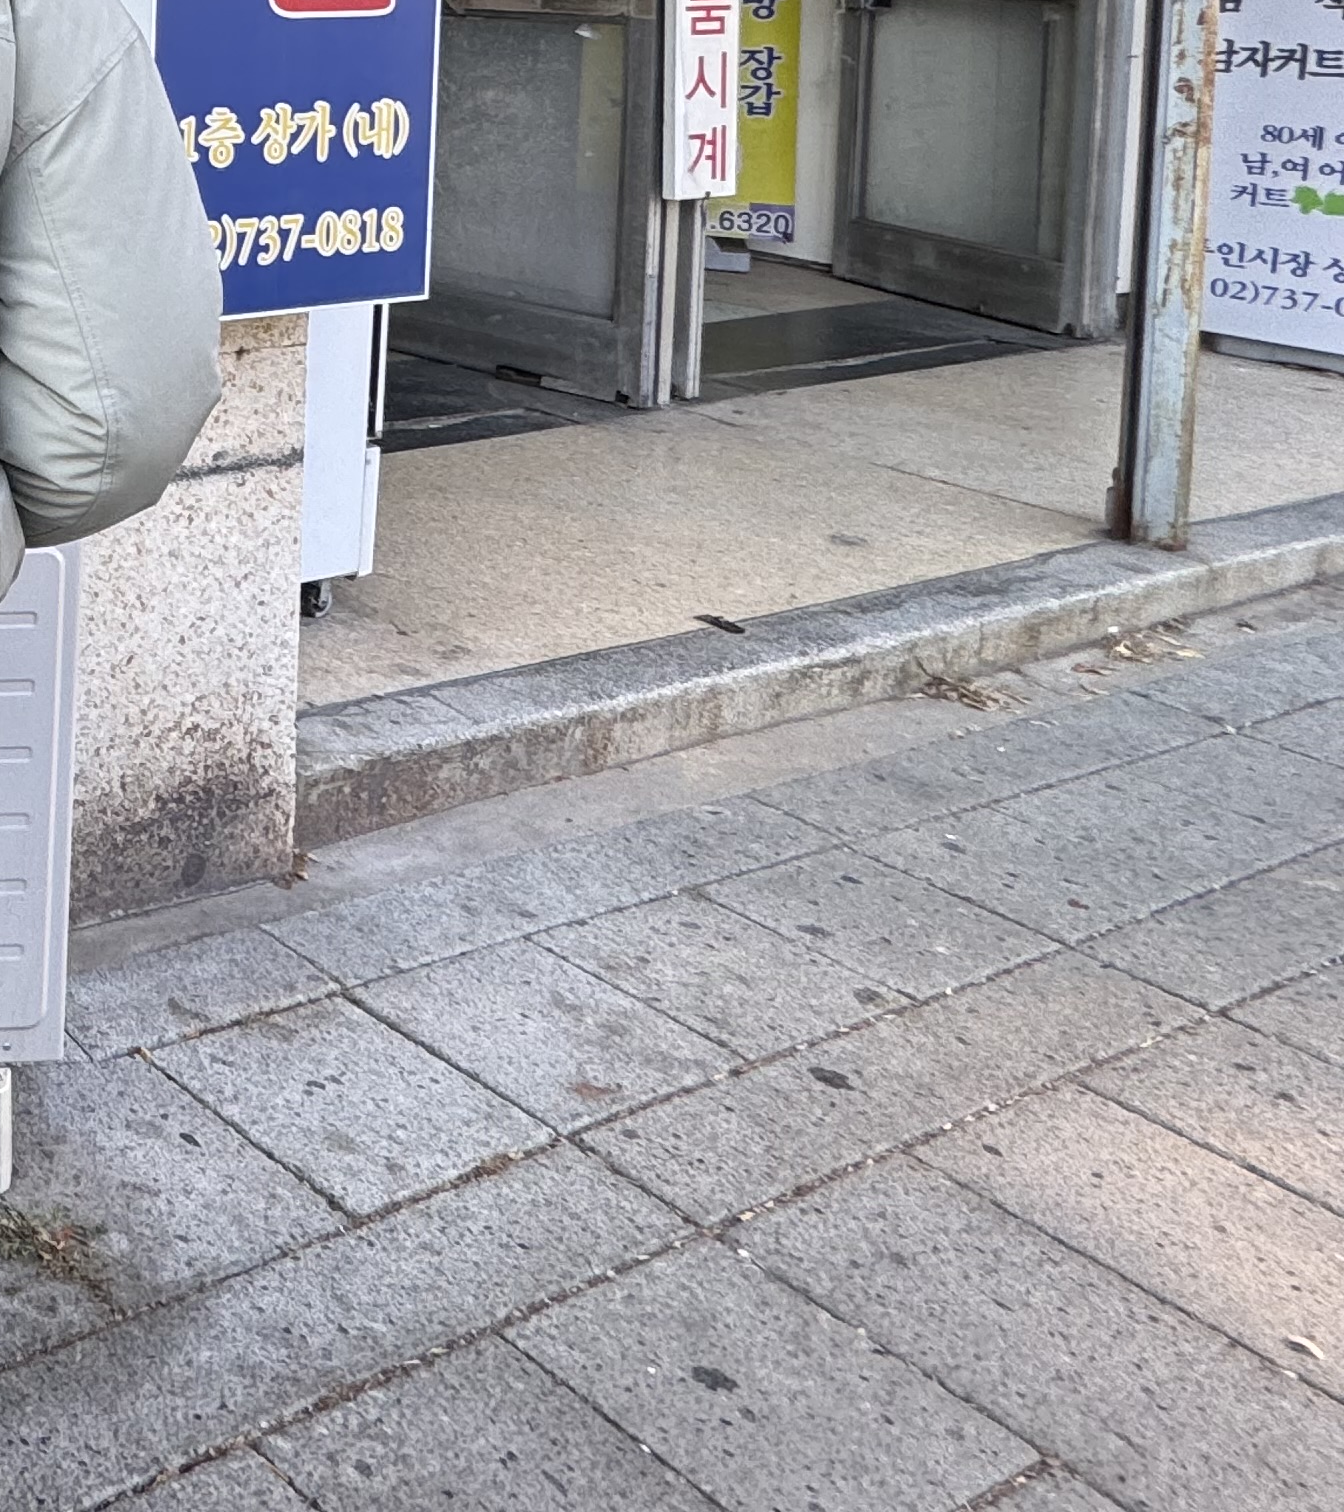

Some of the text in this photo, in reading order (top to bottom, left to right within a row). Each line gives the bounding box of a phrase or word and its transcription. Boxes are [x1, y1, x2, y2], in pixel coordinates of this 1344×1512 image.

[738, 46, 783, 118] 장갑
[179, 97, 410, 169] 1층 상가 (내)
[1260, 124, 1324, 151] 80세
[1230, 182, 1291, 208] 커트
[1204, 238, 1317, 279] 인시장
